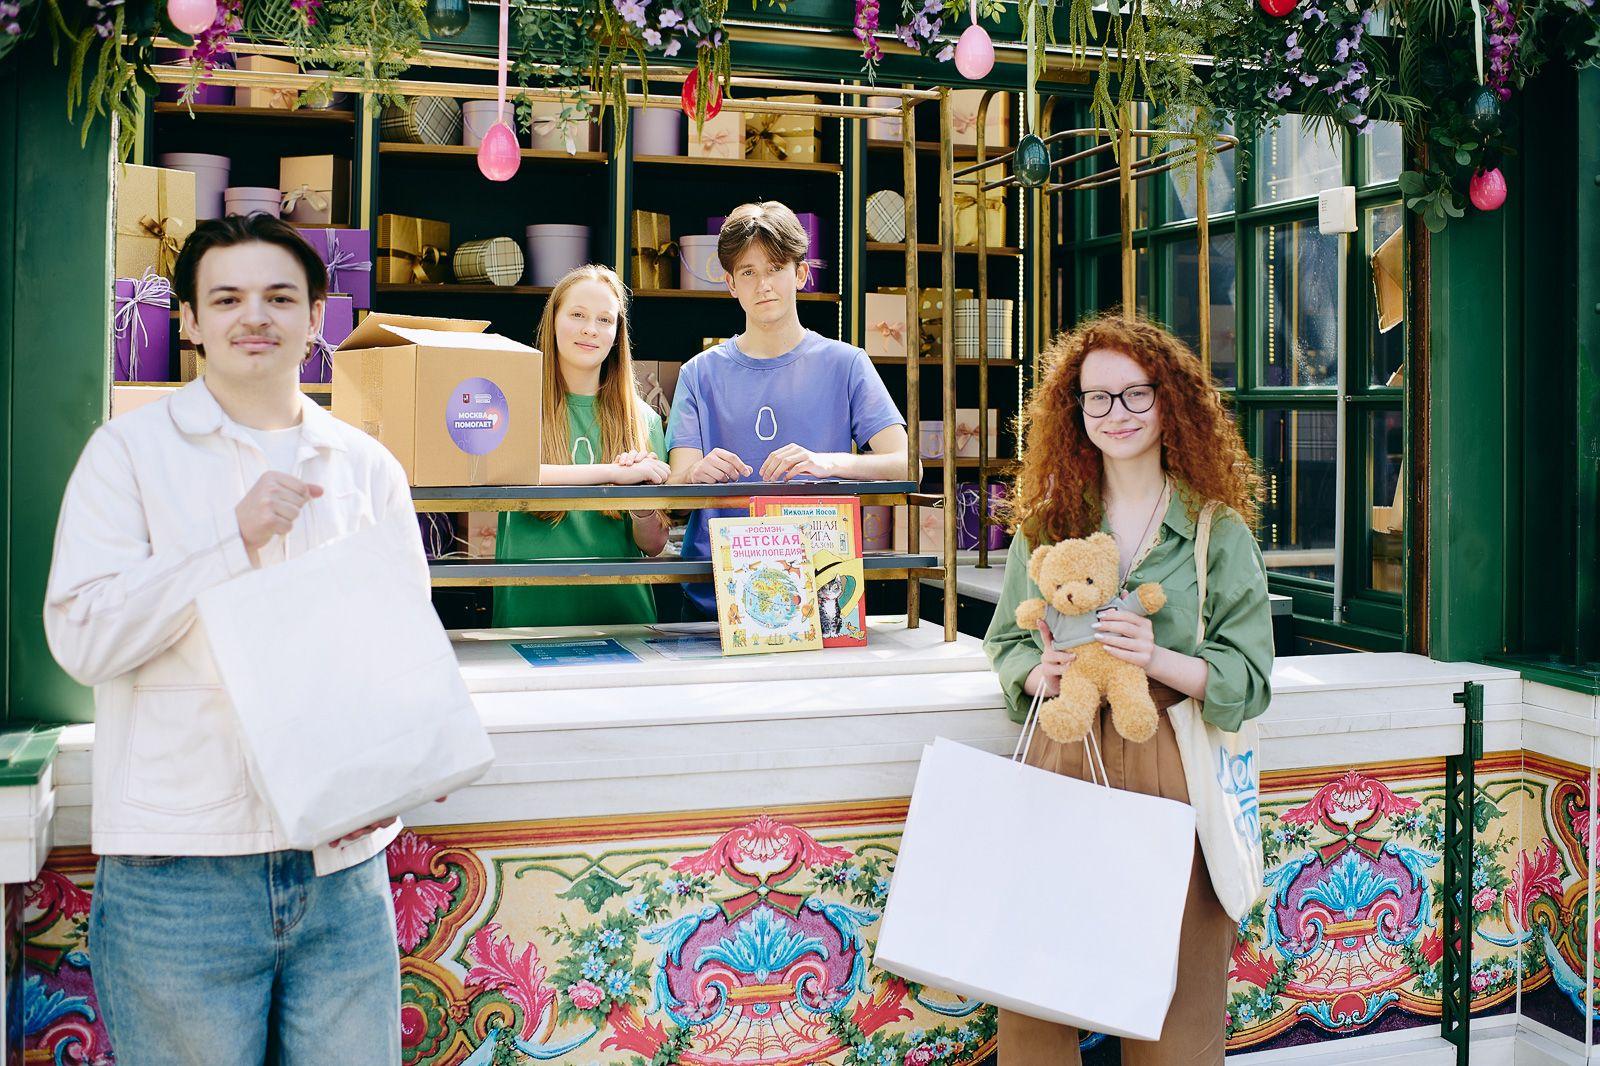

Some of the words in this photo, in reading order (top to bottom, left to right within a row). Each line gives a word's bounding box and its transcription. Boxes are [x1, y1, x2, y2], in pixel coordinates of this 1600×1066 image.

[454, 421, 492, 429] ПОМОГАЕТ
[732, 534, 801, 549] ДЕТСКАЯ
[732, 547, 803, 559] ЭНЦИКЛОПЕДИЯ
